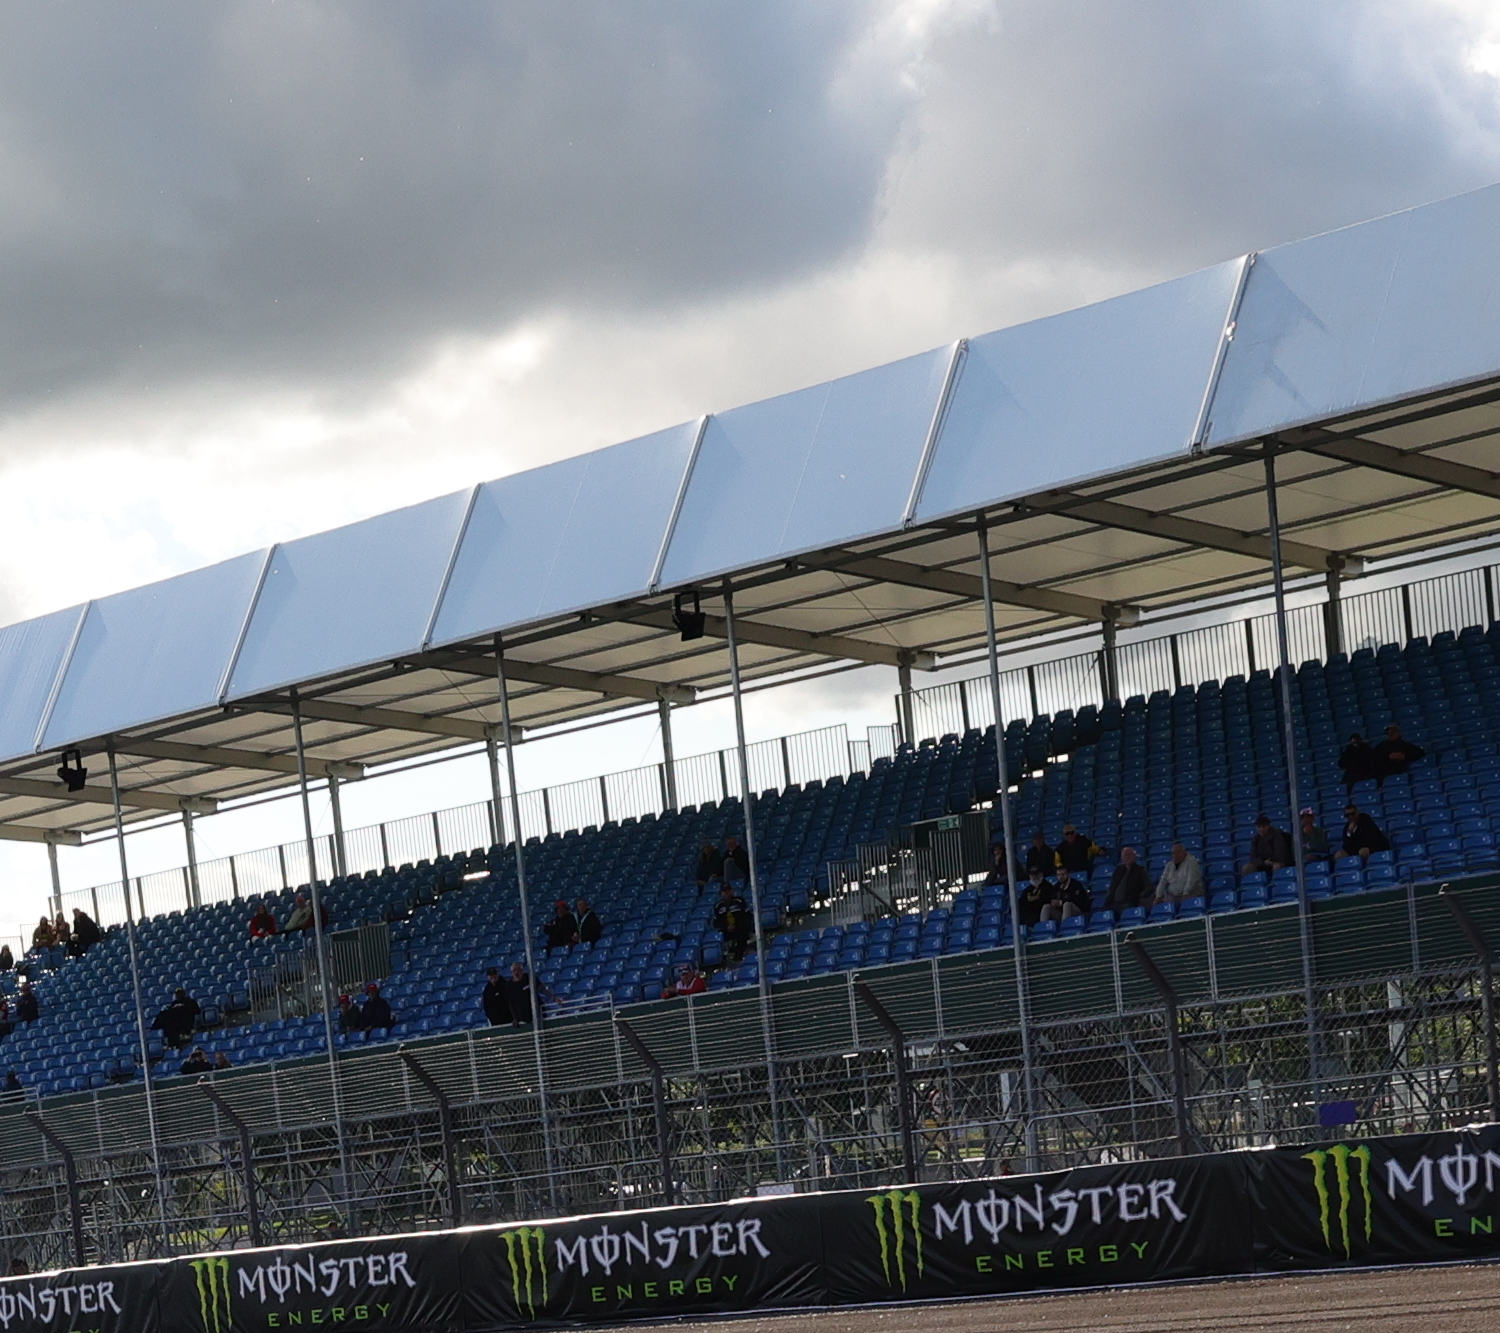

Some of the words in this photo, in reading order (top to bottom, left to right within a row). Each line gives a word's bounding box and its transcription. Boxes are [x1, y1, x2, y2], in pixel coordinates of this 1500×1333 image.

[932, 1178, 1187, 1245] MONSTER
[554, 1218, 771, 1277] MONSTER
[976, 1241, 1150, 1273] ENERGY
[237, 1251, 417, 1304] MONSTER
[591, 1275, 739, 1302] ENERGY
[267, 1303, 391, 1327] ENERGY
